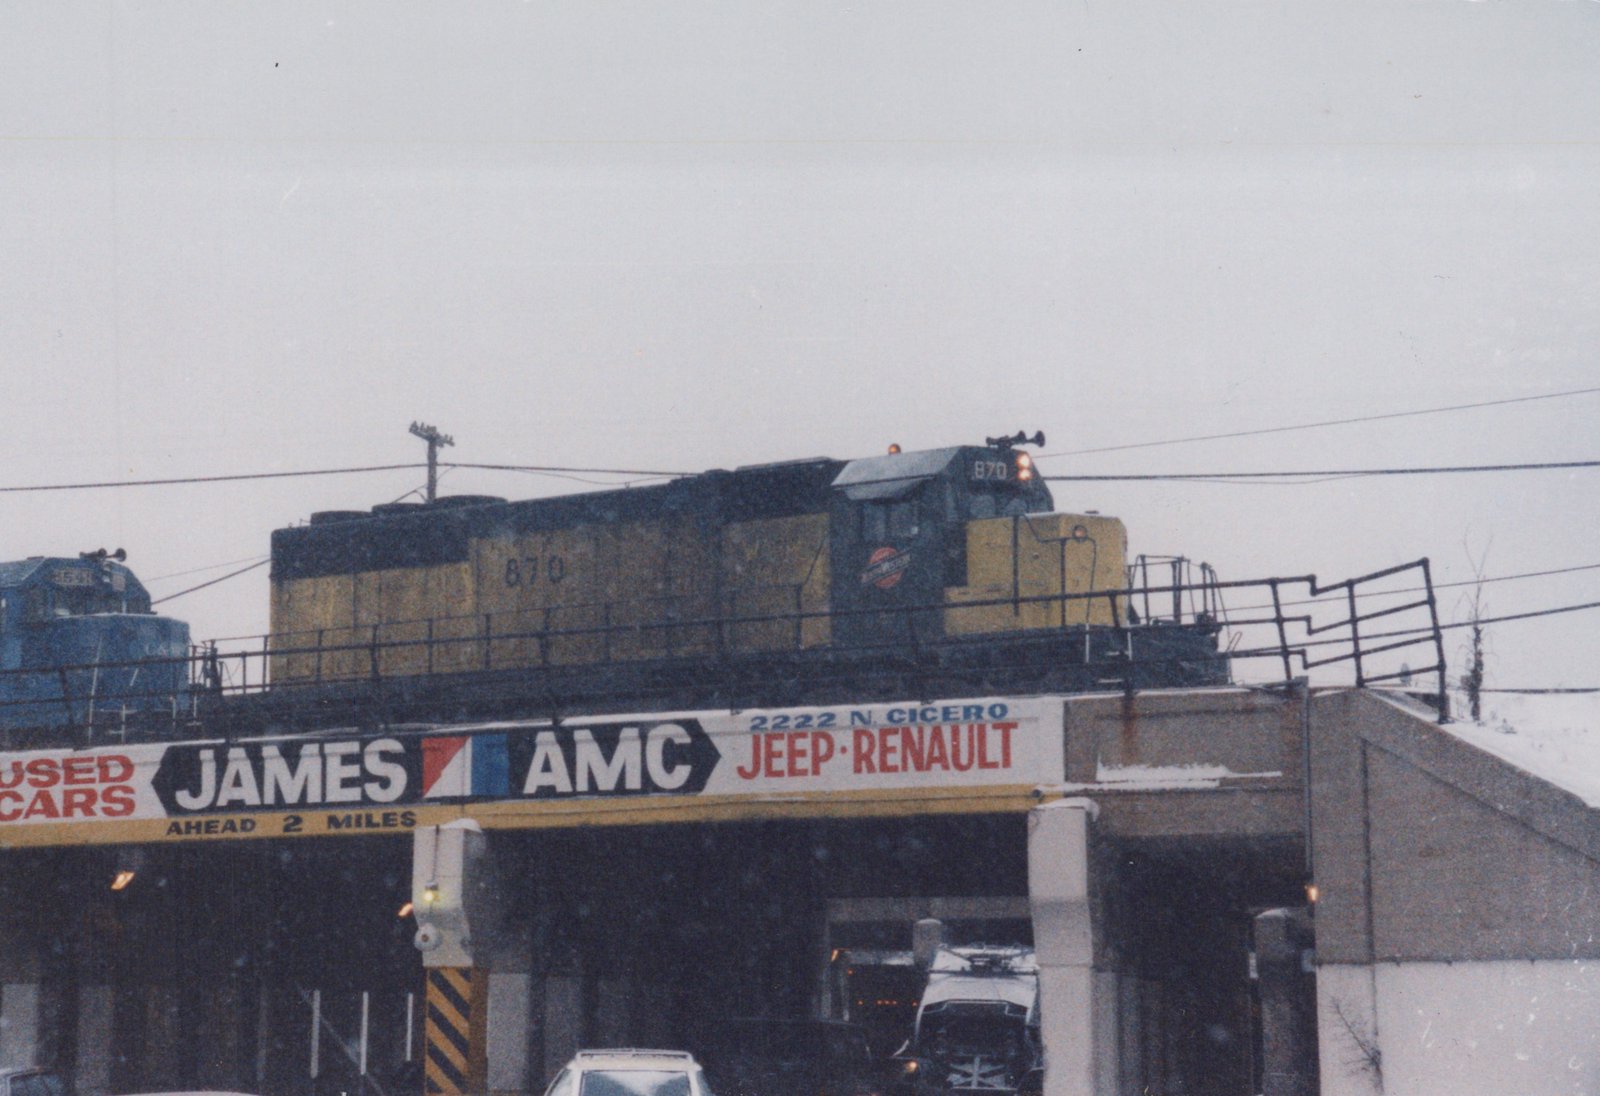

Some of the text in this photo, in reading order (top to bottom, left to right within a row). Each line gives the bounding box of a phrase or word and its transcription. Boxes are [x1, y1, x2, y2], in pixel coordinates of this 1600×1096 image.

[975, 460, 1008, 480] 870
[505, 555, 564, 587] 870
[751, 712, 836, 731] 2222
[887, 703, 1009, 725] CICERO
[0, 755, 134, 789] USED
[175, 723, 692, 811] JAMES AMC
[0, 785, 136, 821] CARS
[167, 811, 416, 836] AHEAD 2 MILES
